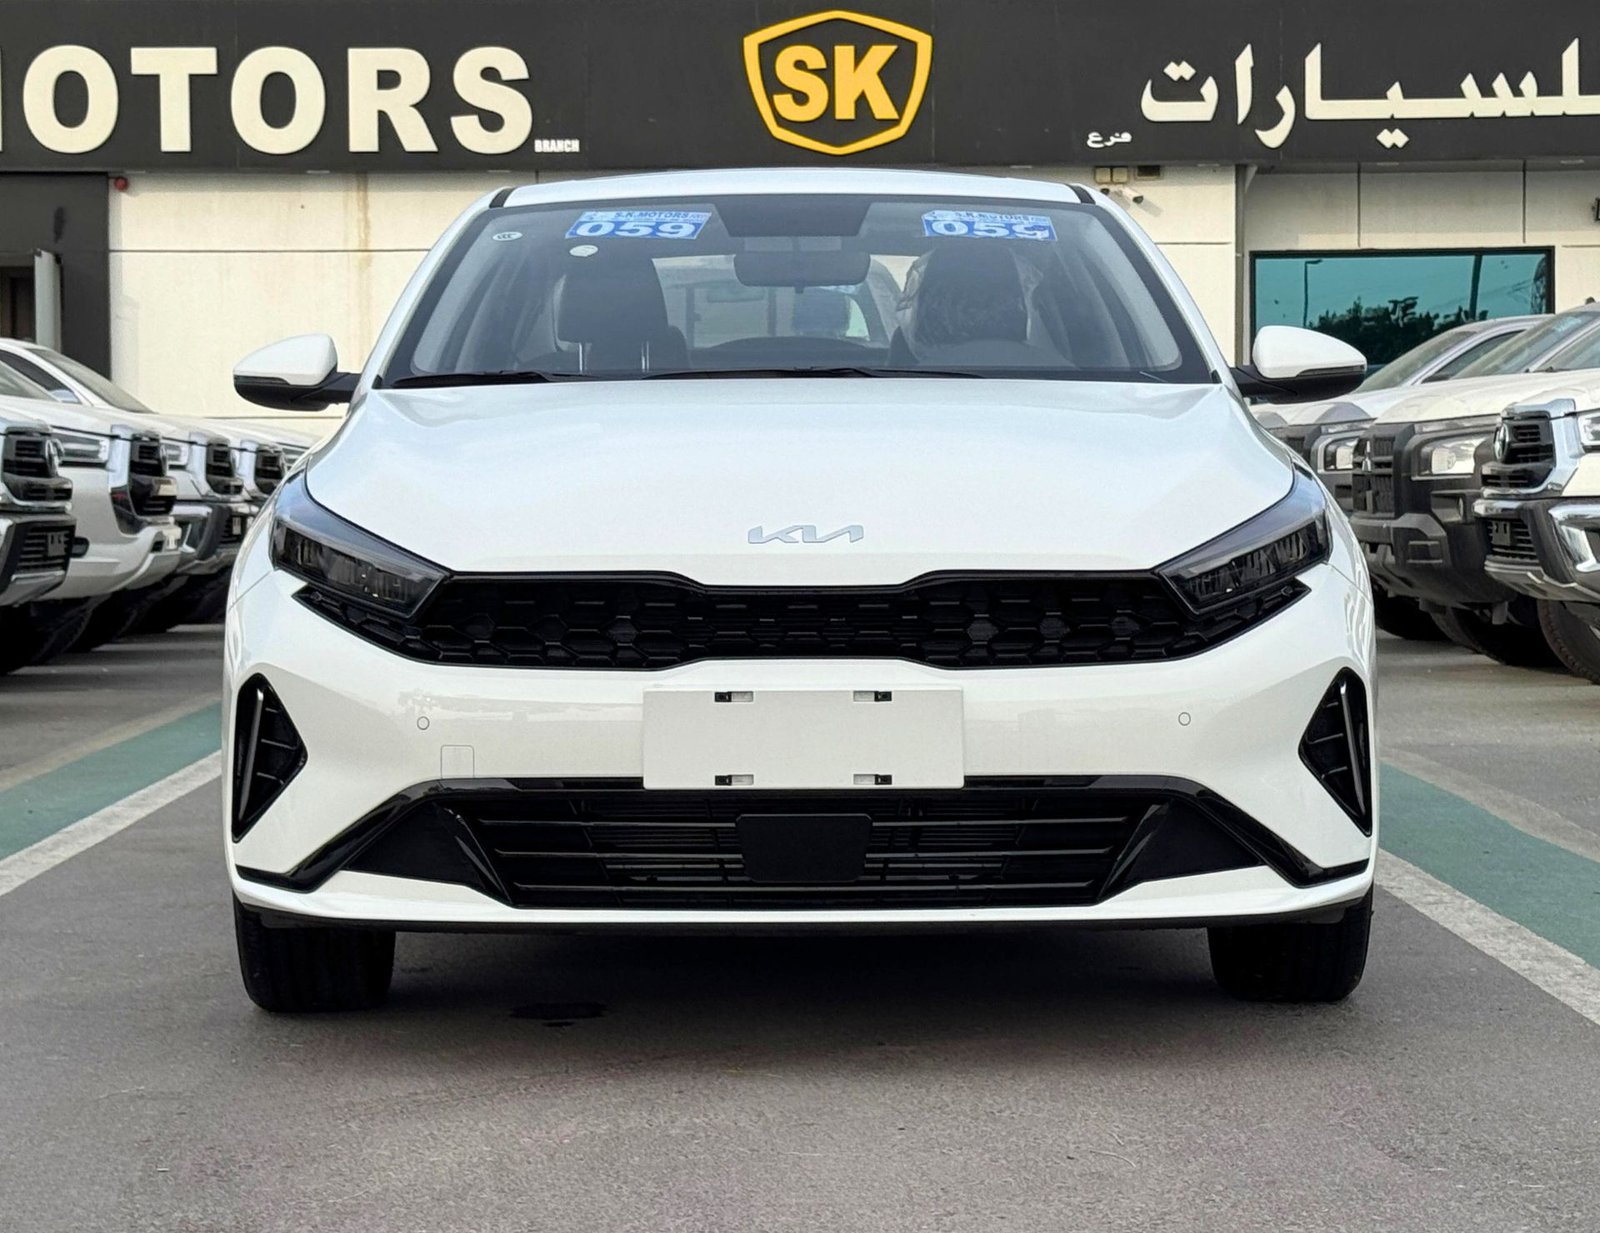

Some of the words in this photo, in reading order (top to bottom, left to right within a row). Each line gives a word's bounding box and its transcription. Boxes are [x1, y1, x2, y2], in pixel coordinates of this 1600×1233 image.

[772, 44, 900, 123] SK
[1140, 37, 1600, 149] لسيارات
[0, 45, 533, 155] OTORS
[534, 138, 580, 153] BRANCH
[1086, 131, 1133, 149] فرع
[576, 221, 697, 238] 059
[747, 524, 864, 544] KIA
